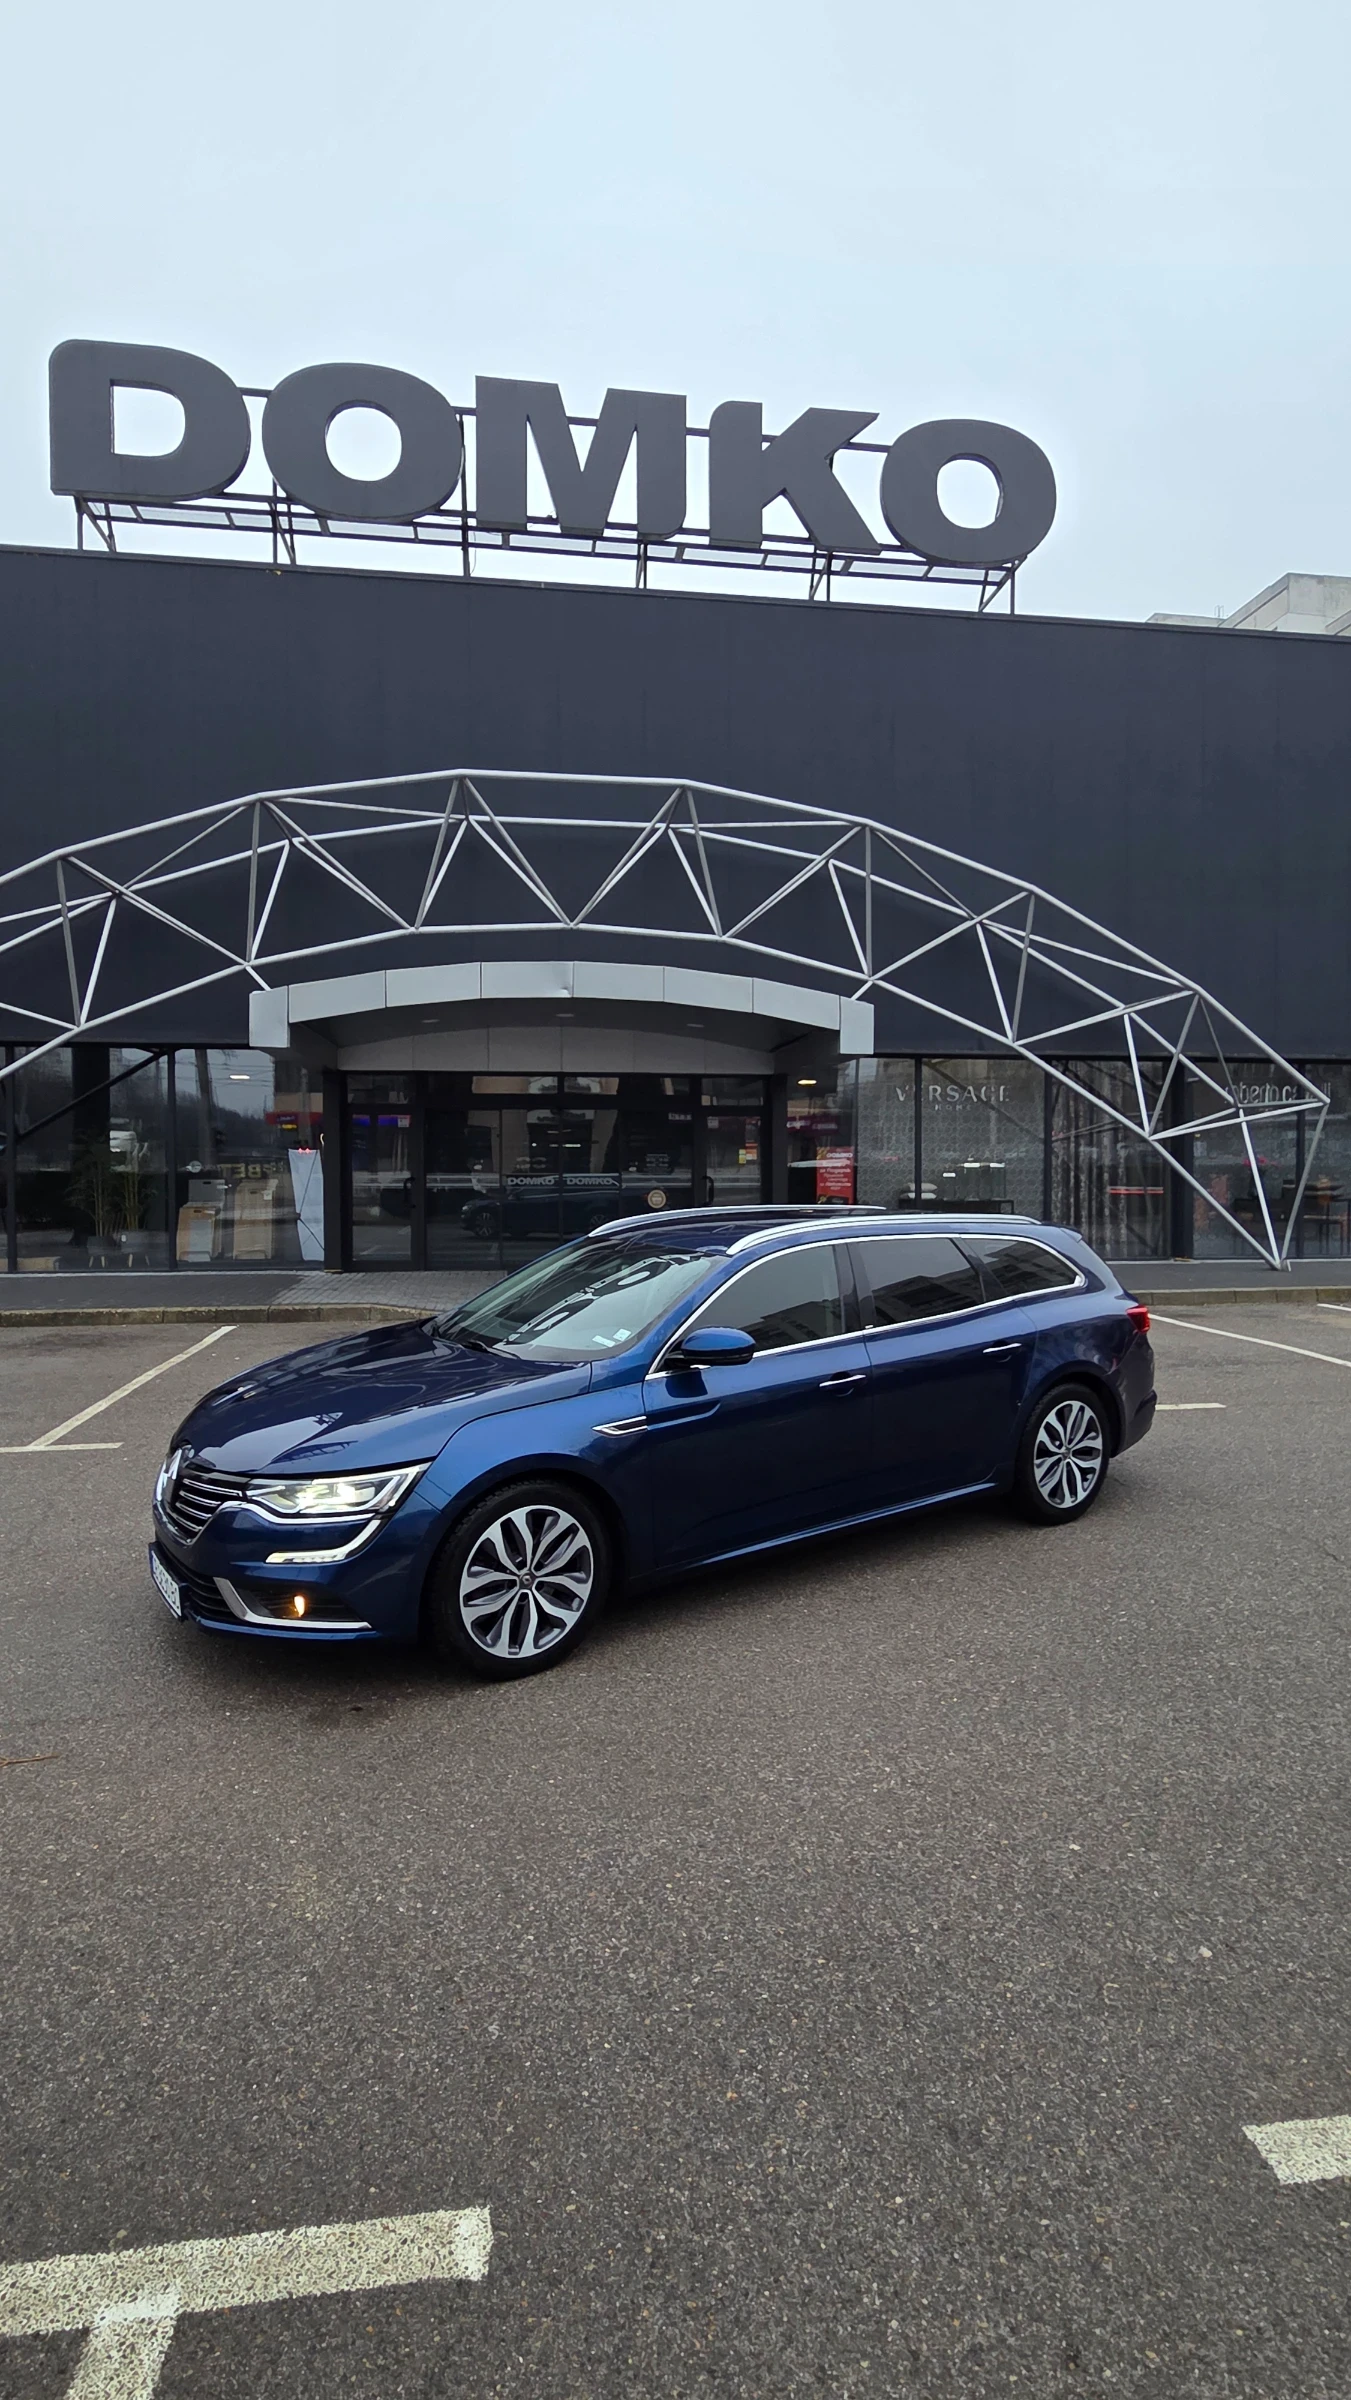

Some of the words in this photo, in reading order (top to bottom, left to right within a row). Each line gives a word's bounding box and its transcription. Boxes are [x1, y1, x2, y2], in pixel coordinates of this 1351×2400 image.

[49, 338, 1057, 566] DOMKO
[895, 1084, 1010, 1102] VRSACE
[507, 1177, 555, 1186] DOMKO
[566, 1177, 612, 1186] DOMKO
